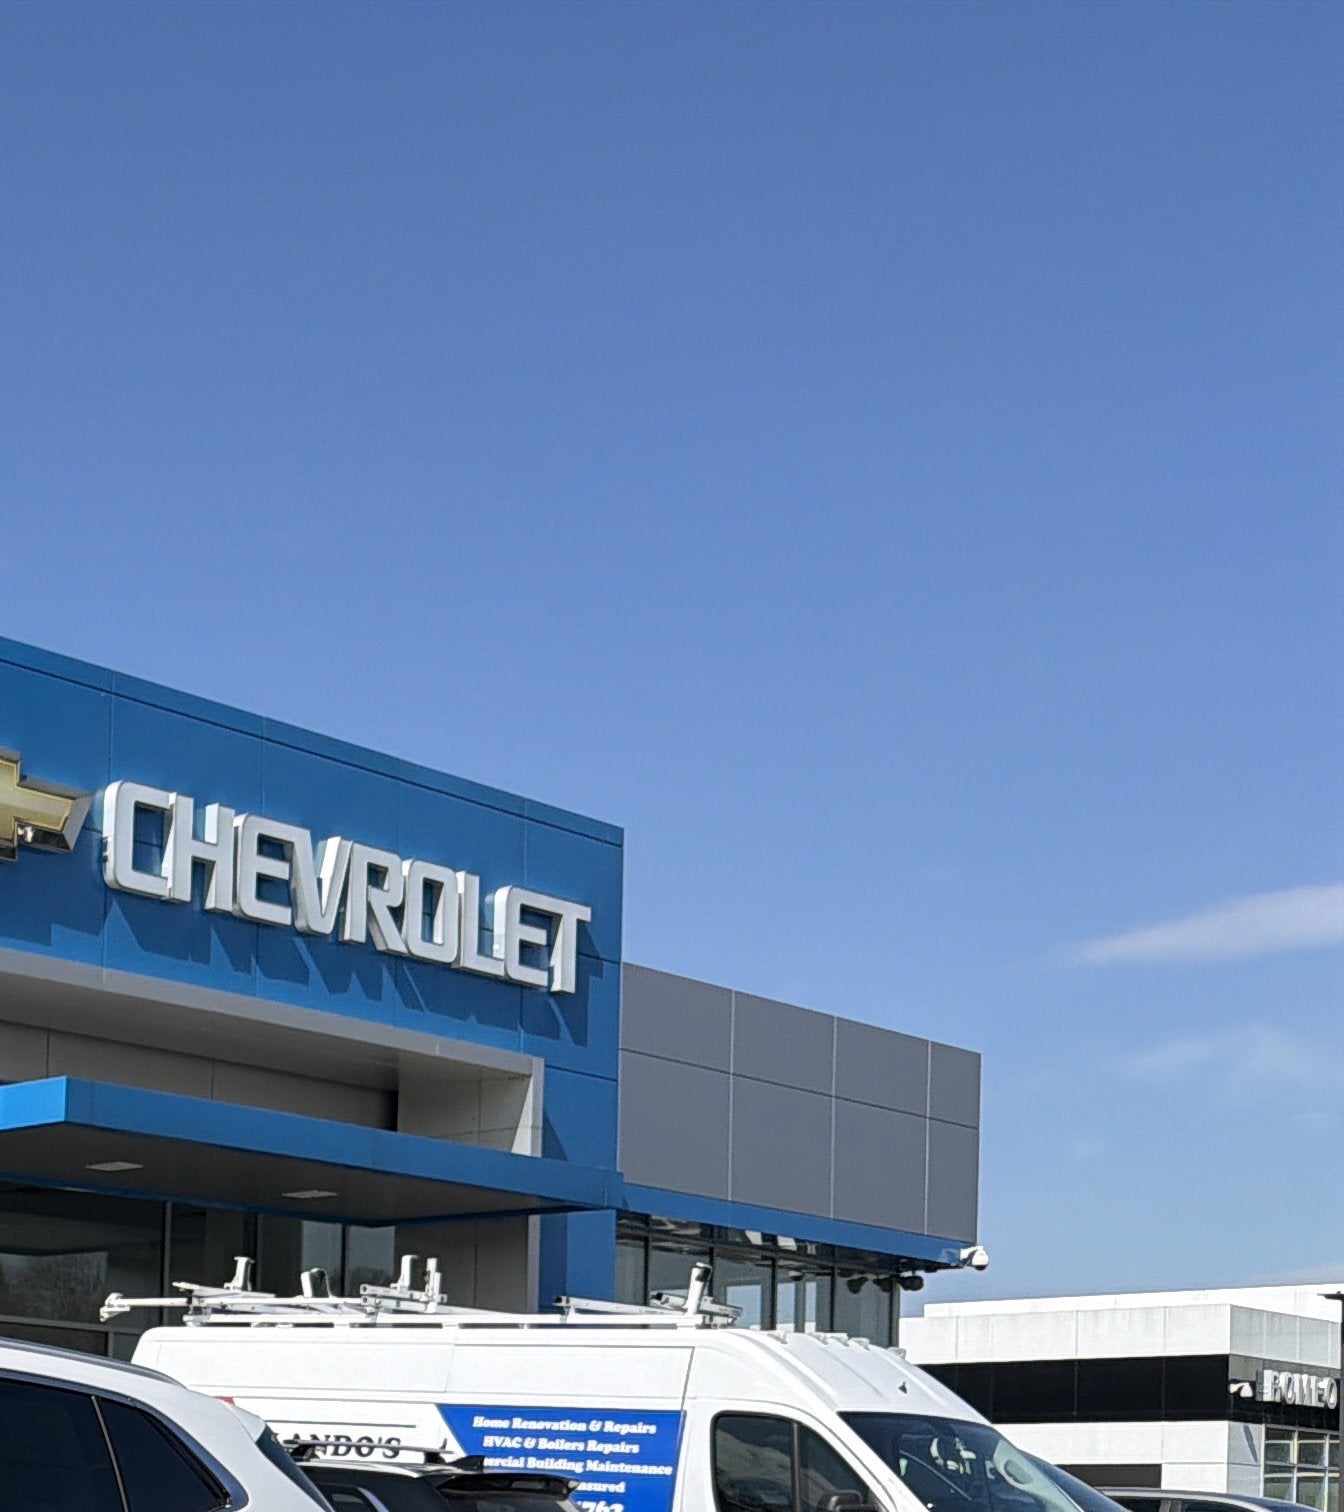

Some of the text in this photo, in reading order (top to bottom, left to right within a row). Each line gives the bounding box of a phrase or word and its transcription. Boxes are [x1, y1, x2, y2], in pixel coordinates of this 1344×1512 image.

[103, 779, 592, 995] CHEVROLET
[1263, 1369, 1338, 1410] ROMEO
[472, 1415, 657, 1436] Home Renovation & Repairs
[483, 1435, 640, 1455] HVAC & Boilers Repairs
[527, 1457, 584, 1473] Building
[586, 1460, 673, 1476] Maintenance
